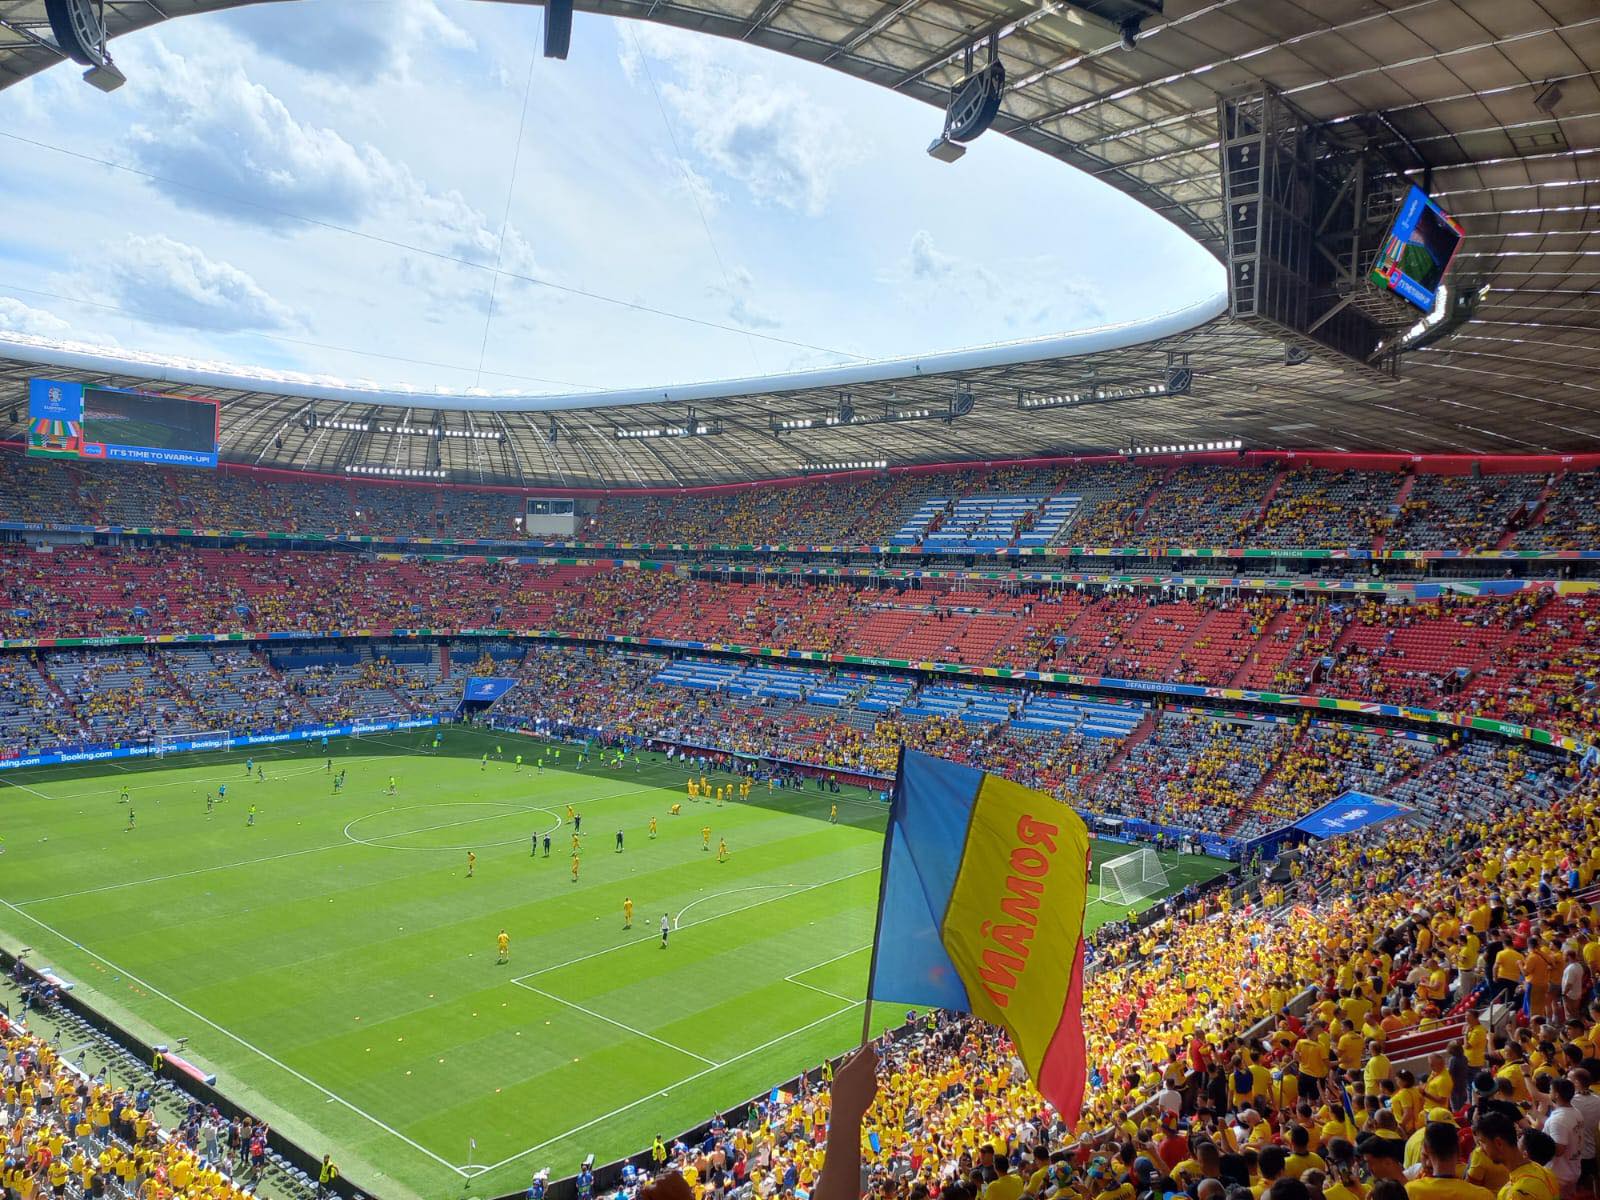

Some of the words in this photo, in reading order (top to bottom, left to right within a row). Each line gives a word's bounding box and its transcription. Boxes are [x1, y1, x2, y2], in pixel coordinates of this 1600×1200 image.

[127, 450, 149, 458] TIME
[163, 452, 210, 463] WARM-UP!
[302, 729, 340, 738] Boking.com
[1499, 725, 1524, 736] MUNIC
[191, 738, 235, 749] Booking.om
[248, 734, 290, 743] Booking.com
[61, 750, 113, 762] Booking.com
